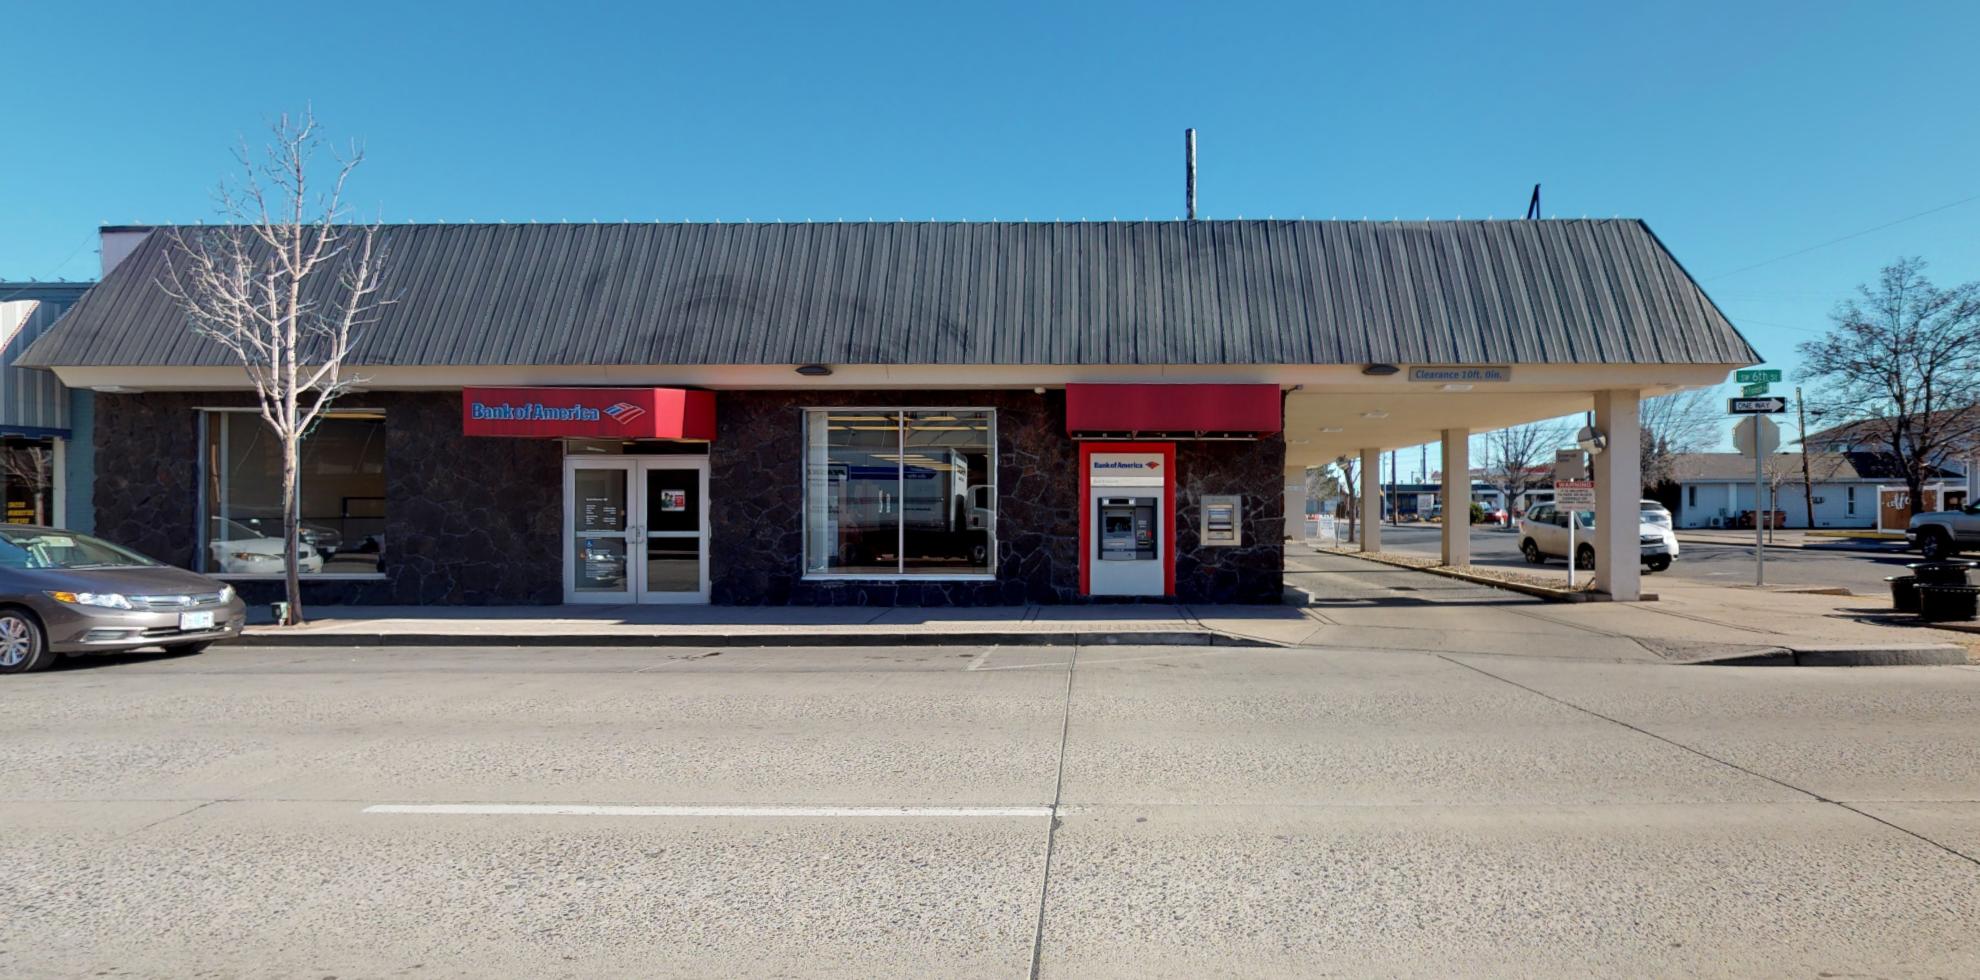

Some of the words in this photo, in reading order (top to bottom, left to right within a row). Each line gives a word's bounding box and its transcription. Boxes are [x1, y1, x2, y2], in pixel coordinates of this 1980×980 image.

[1416, 369, 1459, 379] Clearance
[472, 403, 514, 420] Bank
[514, 404, 533, 420] of
[532, 404, 600, 421] America
